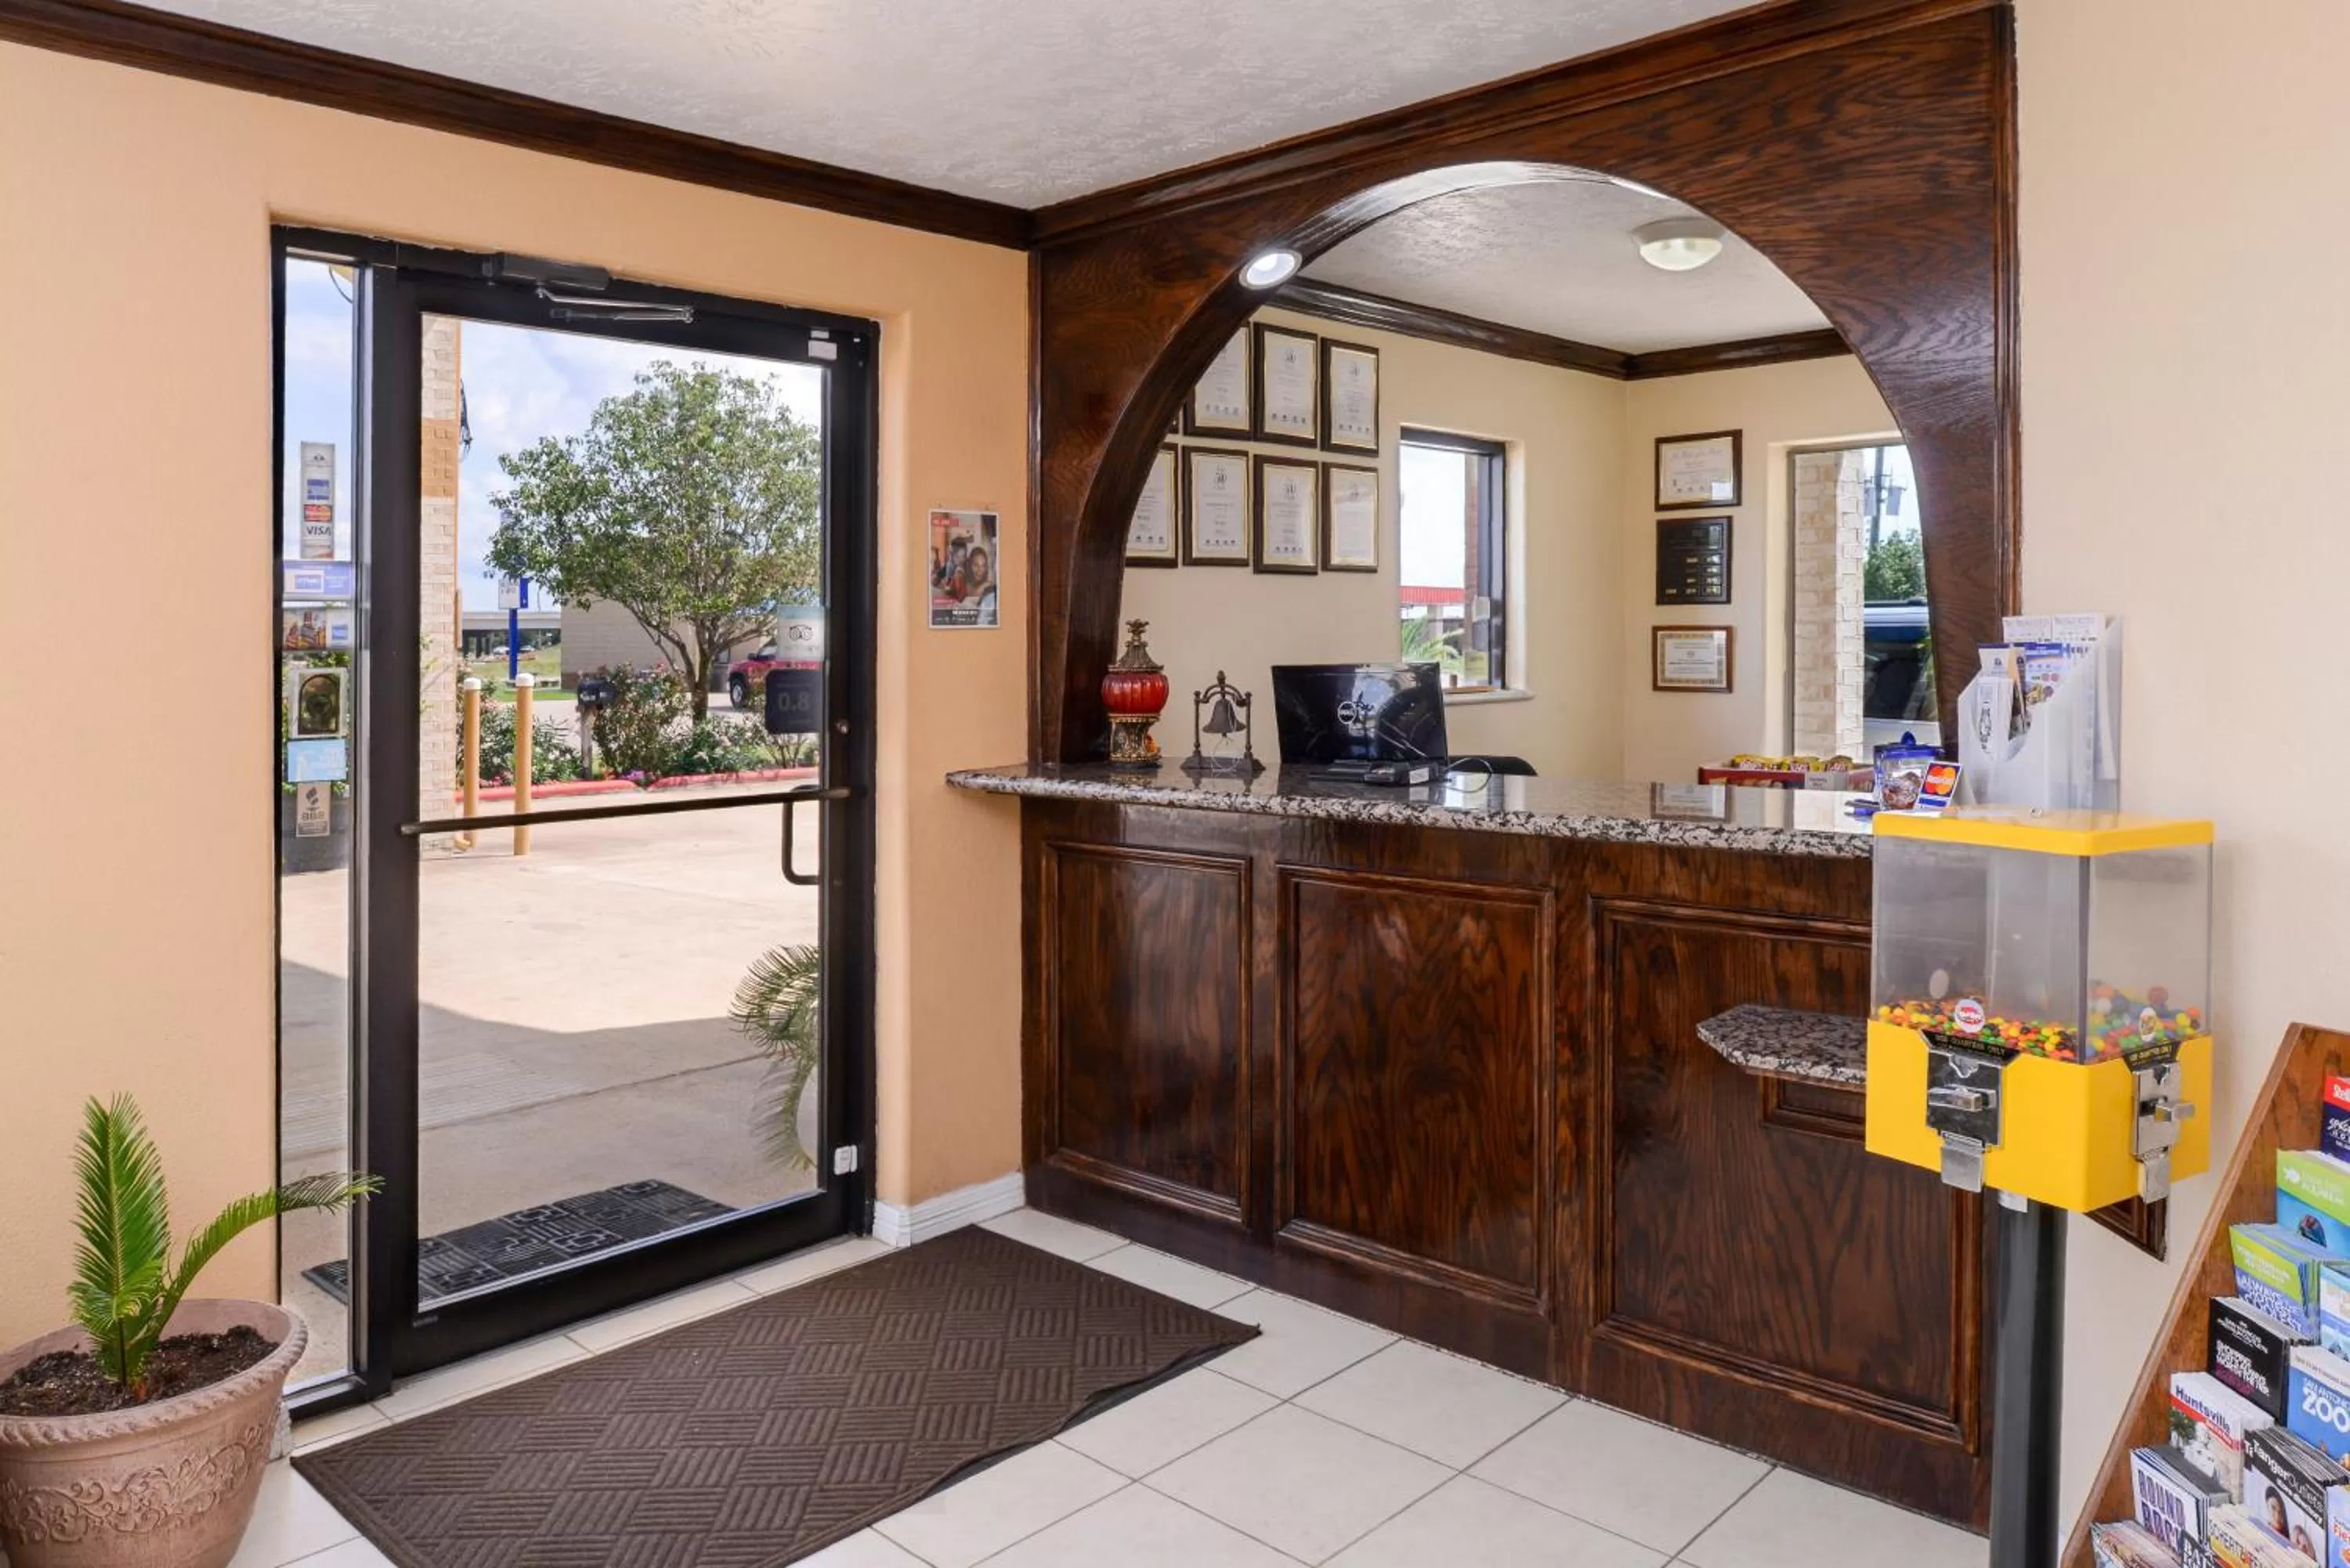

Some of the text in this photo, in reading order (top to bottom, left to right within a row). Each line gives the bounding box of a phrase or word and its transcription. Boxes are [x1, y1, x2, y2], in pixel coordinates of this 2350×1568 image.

[306, 526, 331, 536] VISA
[2175, 1384, 2231, 1436] Huntsville
[2302, 1385, 2350, 1433] ZOO
[2138, 1469, 2186, 1528] ROUND
